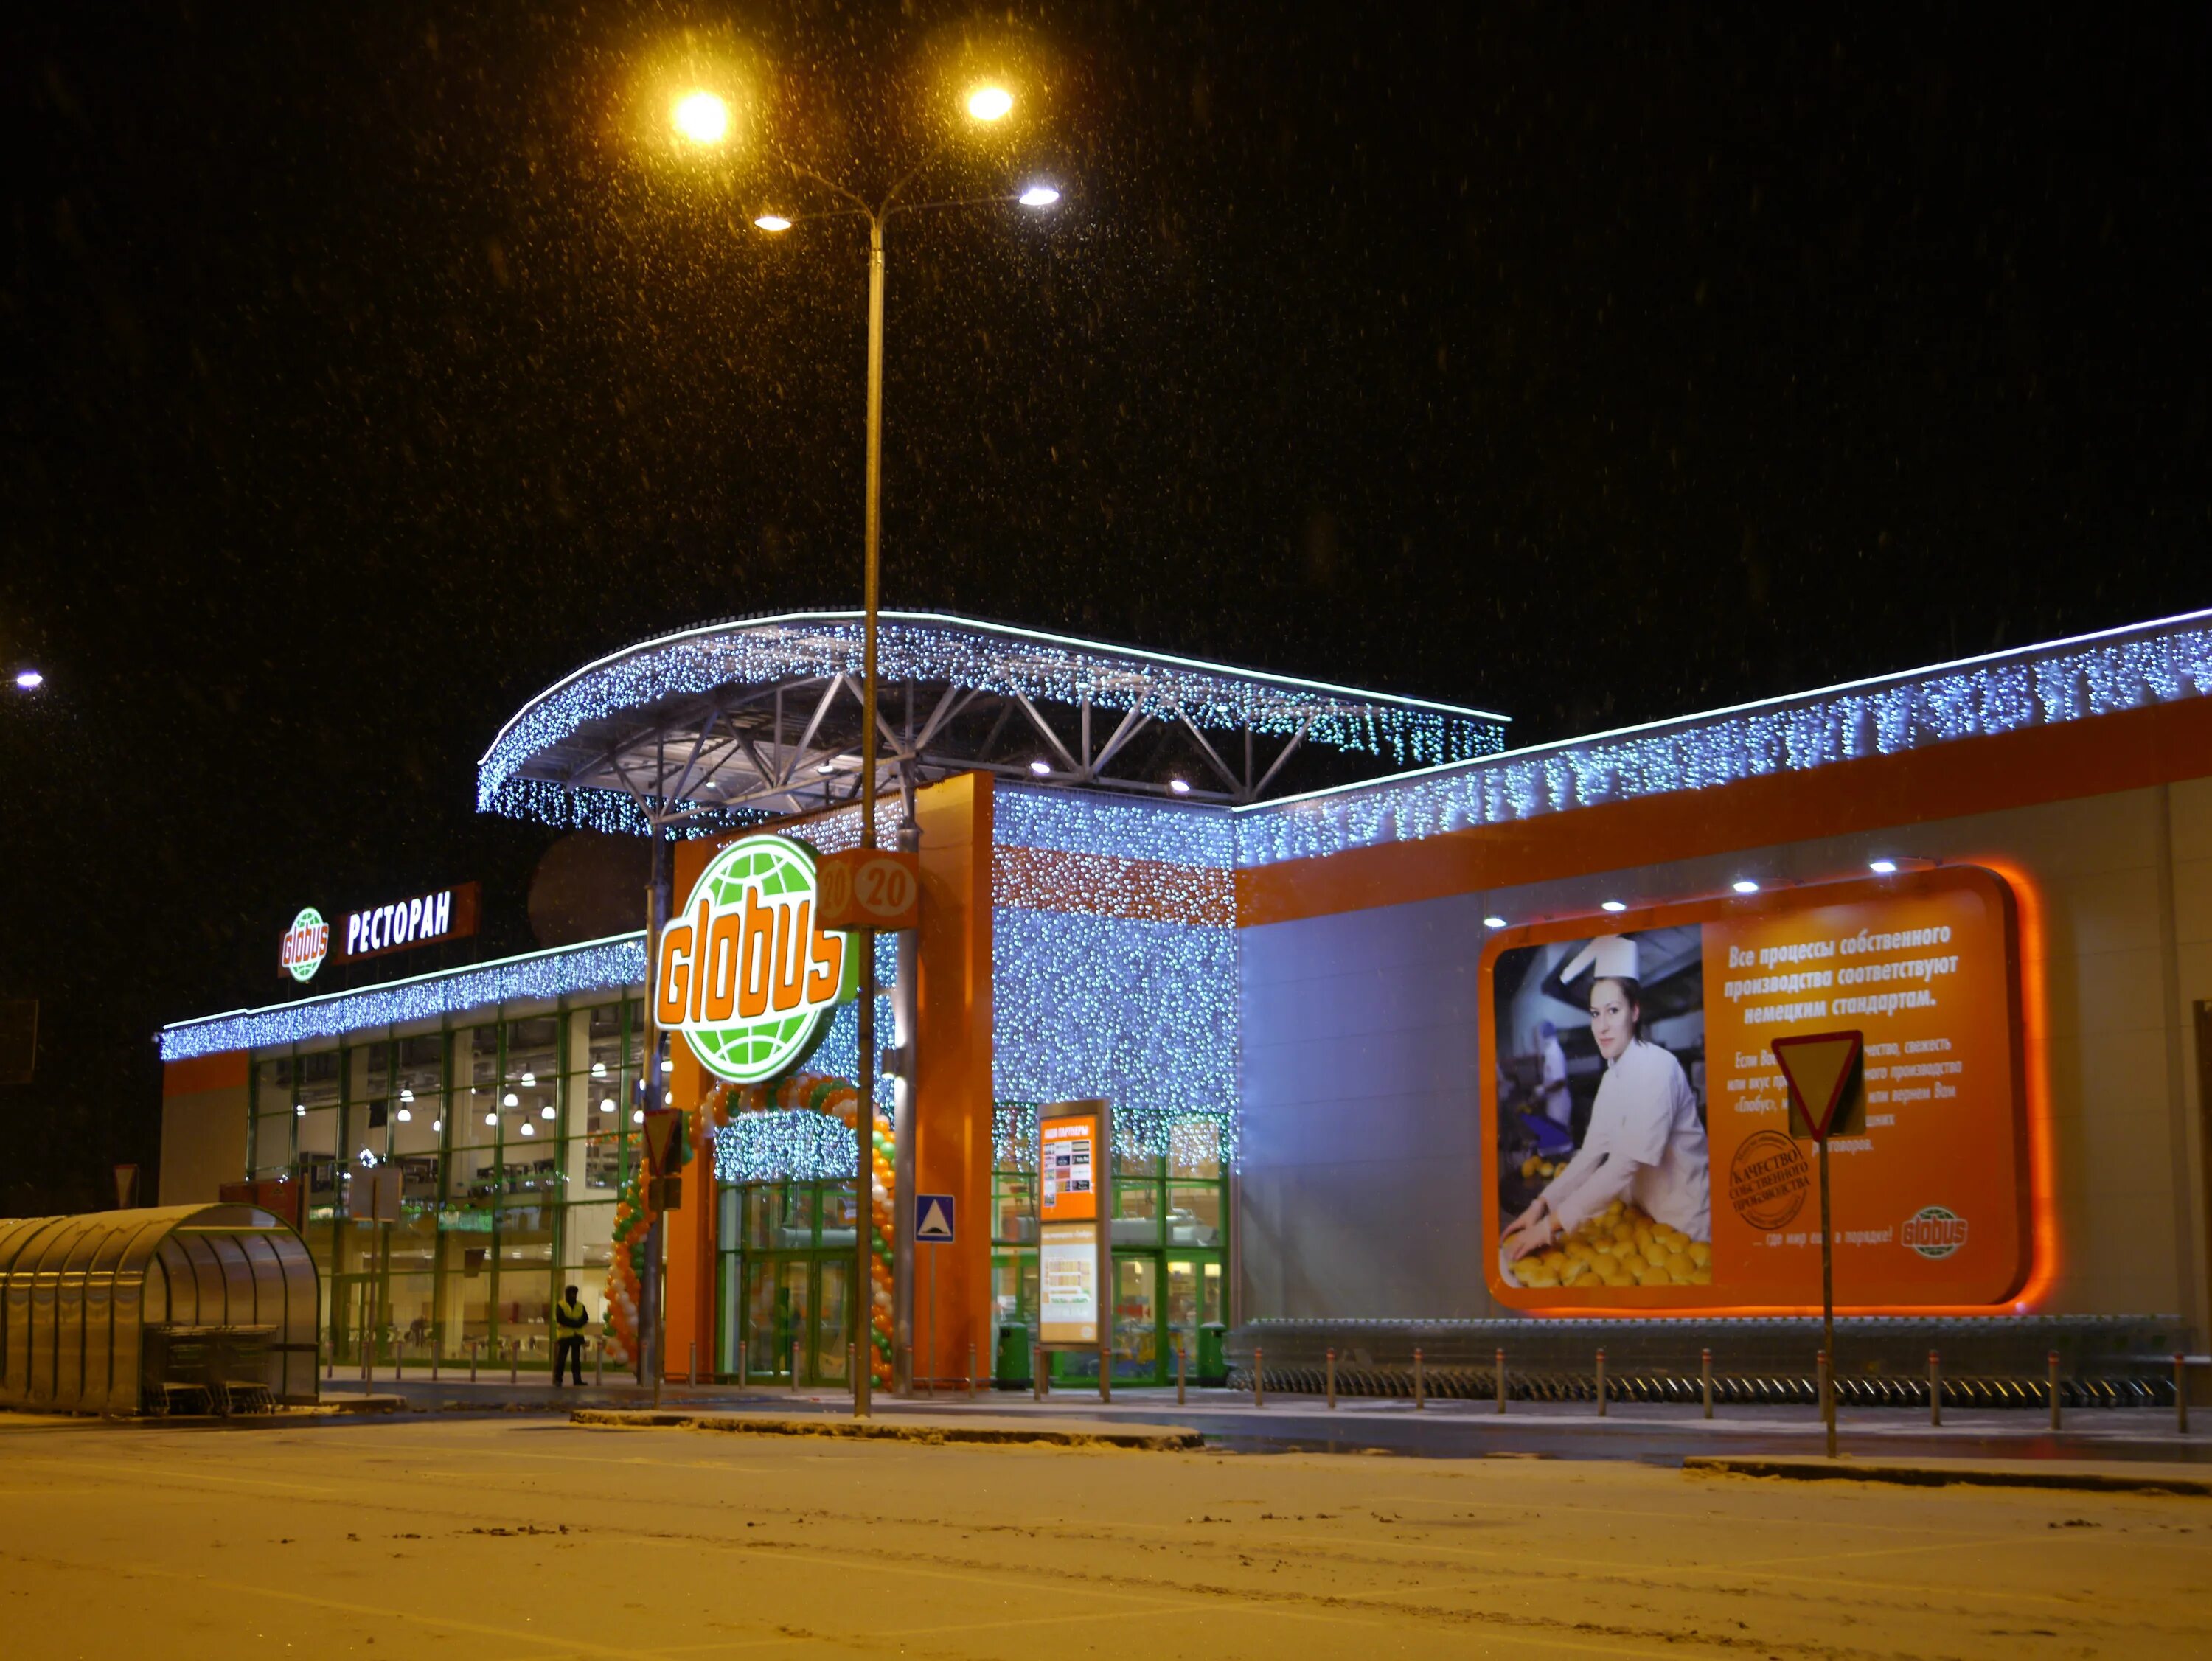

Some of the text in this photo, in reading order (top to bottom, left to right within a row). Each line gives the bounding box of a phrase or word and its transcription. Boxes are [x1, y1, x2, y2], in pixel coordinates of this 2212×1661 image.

[867, 868, 907, 907] 20
[347, 891, 451, 955] РЕСТОРАН
[282, 922, 329, 966] Globus
[657, 885, 843, 1025] Globus
[1729, 926, 1951, 969] Все процессы собственного
[1724, 955, 1958, 1003] производства соответствуют
[1745, 990, 1936, 1024] немецким стандартам.
[1735, 1051, 1758, 1069] Если
[1905, 1038, 1952, 1054] свежесть
[1727, 1079, 1747, 1092] или
[1749, 1076, 1770, 1093] вкус
[1891, 1061, 1963, 1082] производства
[1868, 1090, 1888, 1104] или
[1729, 1162, 1809, 1199] СОБСТВЕННОГО
[1732, 1149, 1798, 1185] КАЧЕСТВО
[1733, 1176, 1810, 1213] ПРОИЗВОДСТВА
[1845, 1225, 1893, 1247] порядке!
[1902, 1216, 1967, 1247] Globus
